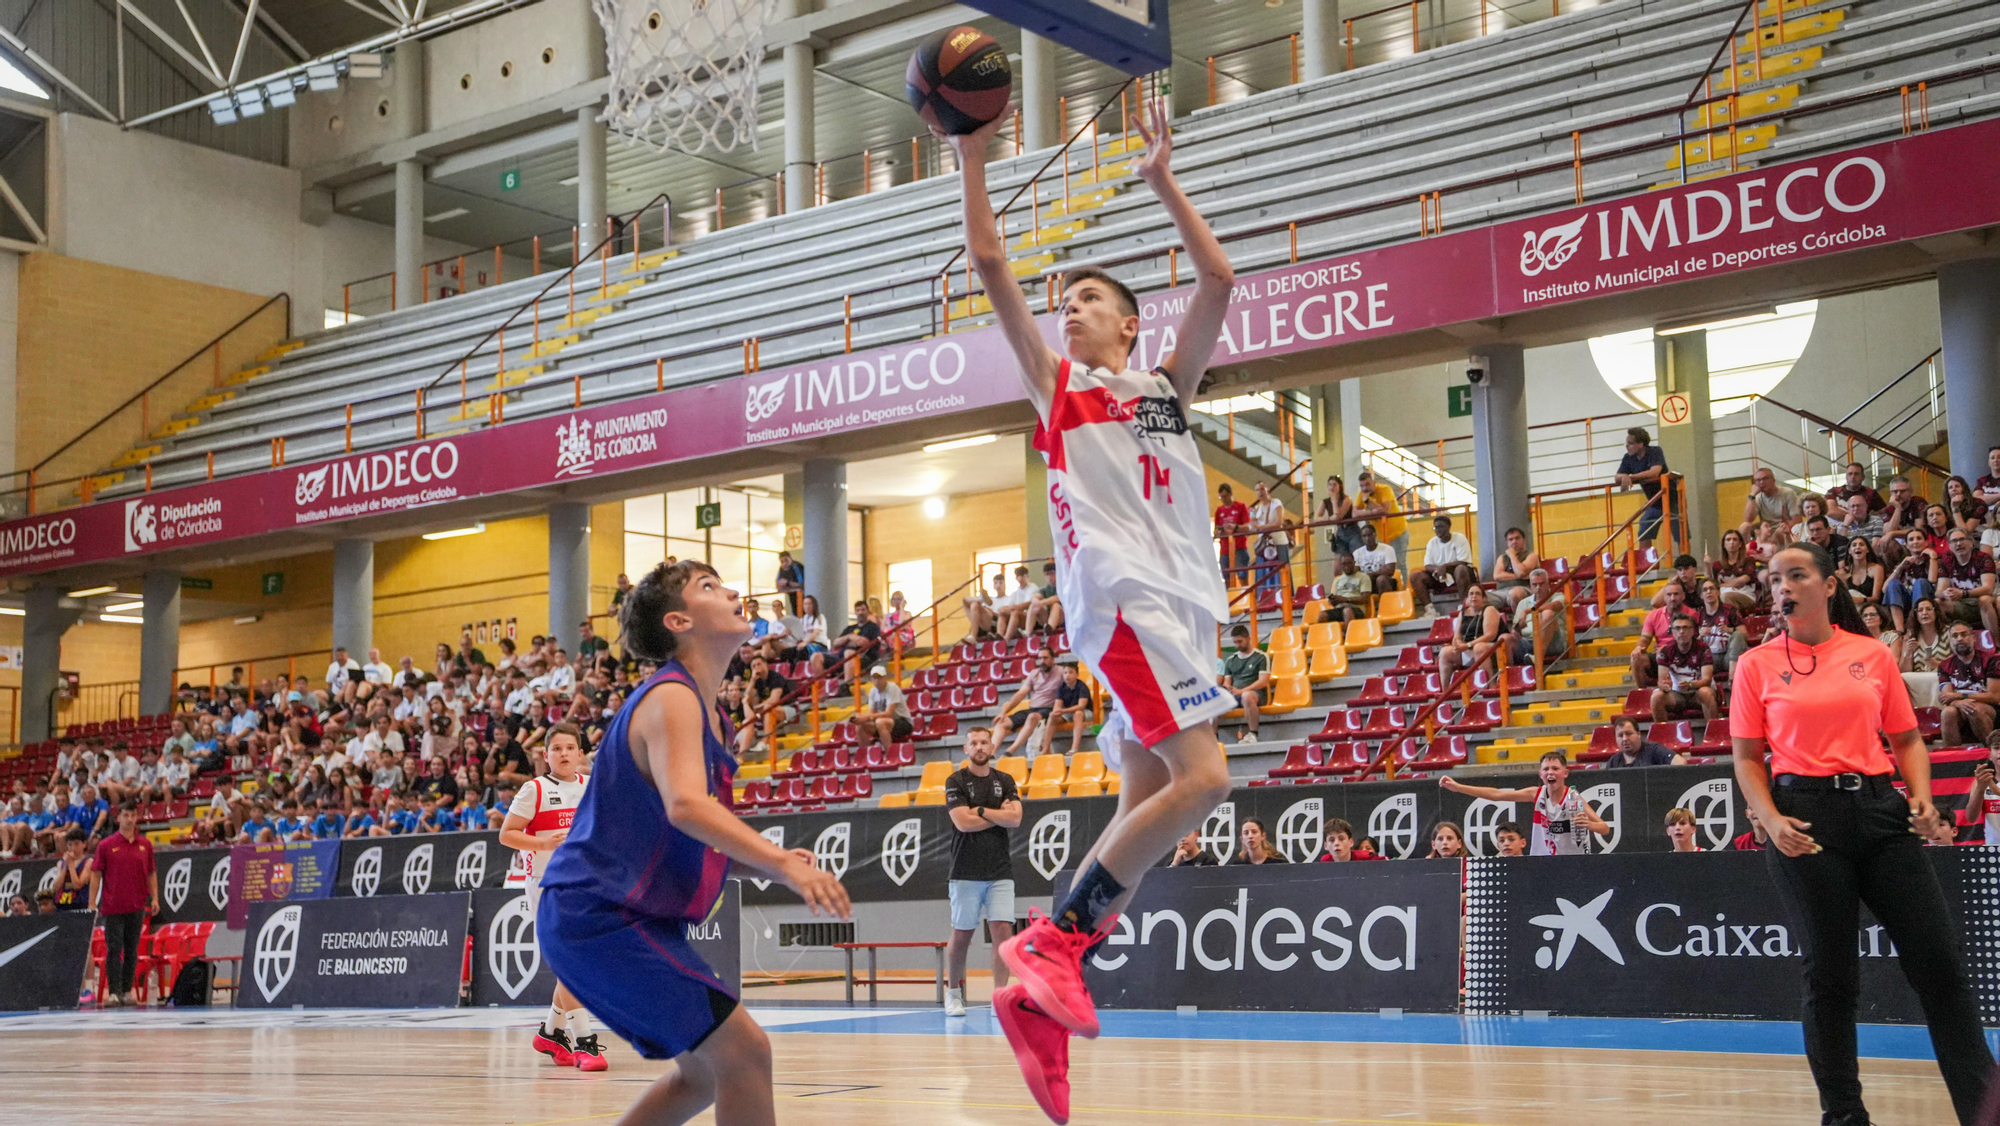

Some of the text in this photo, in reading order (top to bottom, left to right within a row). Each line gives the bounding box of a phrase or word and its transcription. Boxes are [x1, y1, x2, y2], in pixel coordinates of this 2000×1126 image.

[506, 173, 515, 188] 6
[1597, 156, 1886, 262] IMDECO
[1523, 224, 1887, 303] Instituto Municipal de Deportes Córdoba
[1267, 262, 1363, 297] DEPORTES
[794, 342, 966, 413] IMDECO
[594, 408, 667, 439] AYUNTAMIENTO
[746, 394, 965, 443] Instituto Municipal de Deportes Córdoba
[594, 433, 657, 460] DE CÓRDOBA
[332, 441, 459, 498] IMDECO
[1138, 454, 1173, 504] 14
[161, 497, 222, 524] Diputación
[296, 486, 457, 524] Instituto Municipal de Deportes Córdoba
[702, 506, 715, 525] G
[0, 517, 76, 556] IMDECO
[161, 516, 222, 540] de Córdoba
[267, 576, 277, 592] F
[1598, 788, 1616, 797] FEB
[1709, 783, 1728, 793] FEB
[1217, 807, 1231, 815] FEB
[1304, 803, 1320, 811] FEB
[1397, 797, 1412, 806] FEB
[836, 826, 847, 834] FEB
[1054, 814, 1067, 822] FEB
[284, 911, 298, 921] FEB
[321, 927, 449, 949] FEDERACIÓN ESPAÑOLA
[1092, 888, 1417, 972] endesa
[318, 957, 408, 976] DE BALONCESTO
